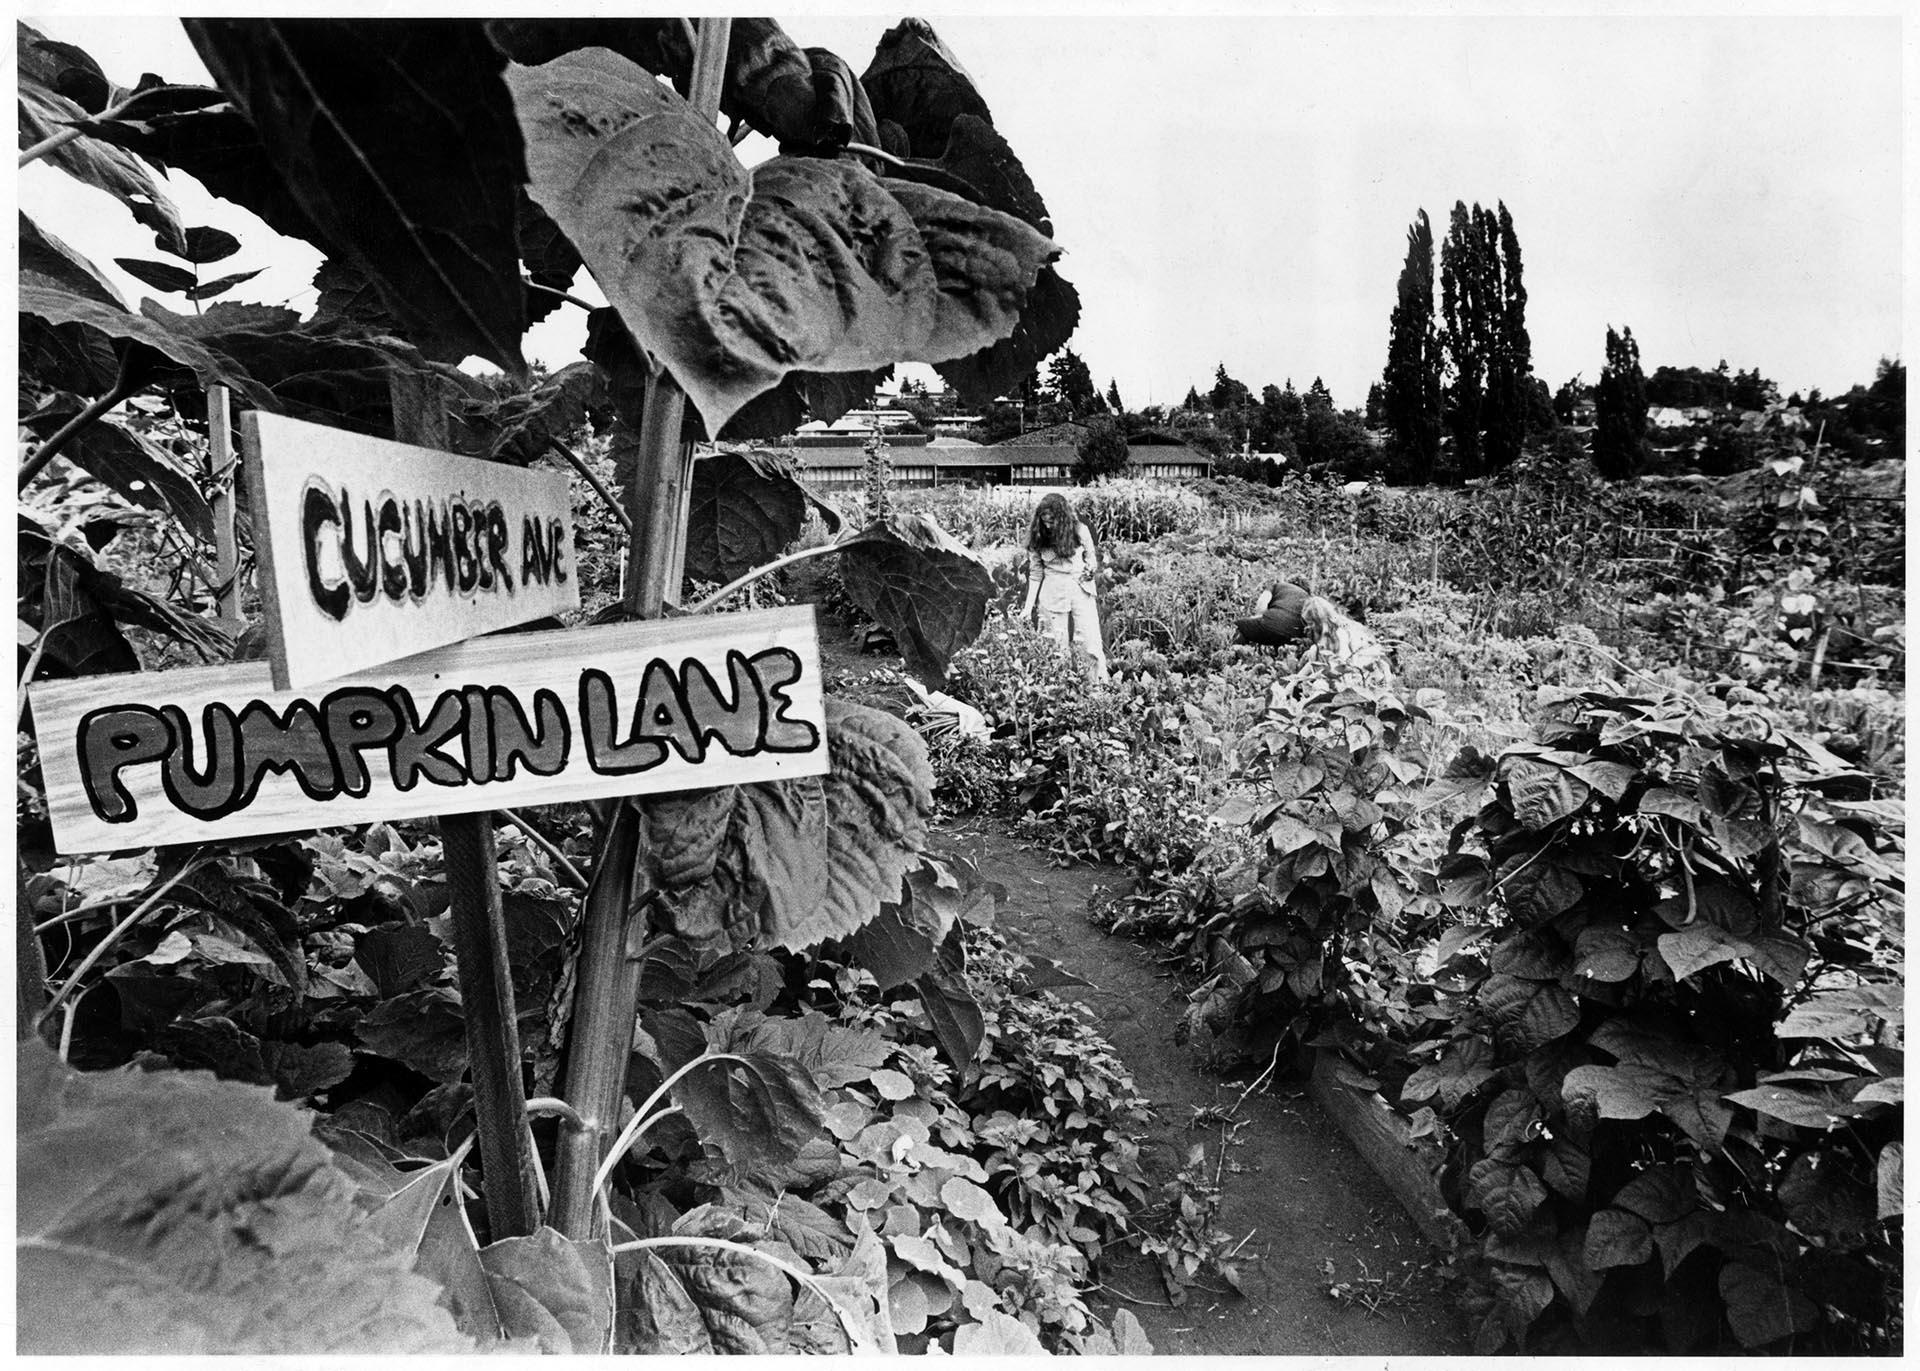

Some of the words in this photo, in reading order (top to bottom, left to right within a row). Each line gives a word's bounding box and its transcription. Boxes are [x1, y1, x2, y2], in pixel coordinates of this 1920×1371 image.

[301, 475, 514, 623] CUCUMBER
[521, 510, 568, 587] AVE
[77, 684, 571, 823] PUMPKIN
[578, 647, 820, 776] LANE
